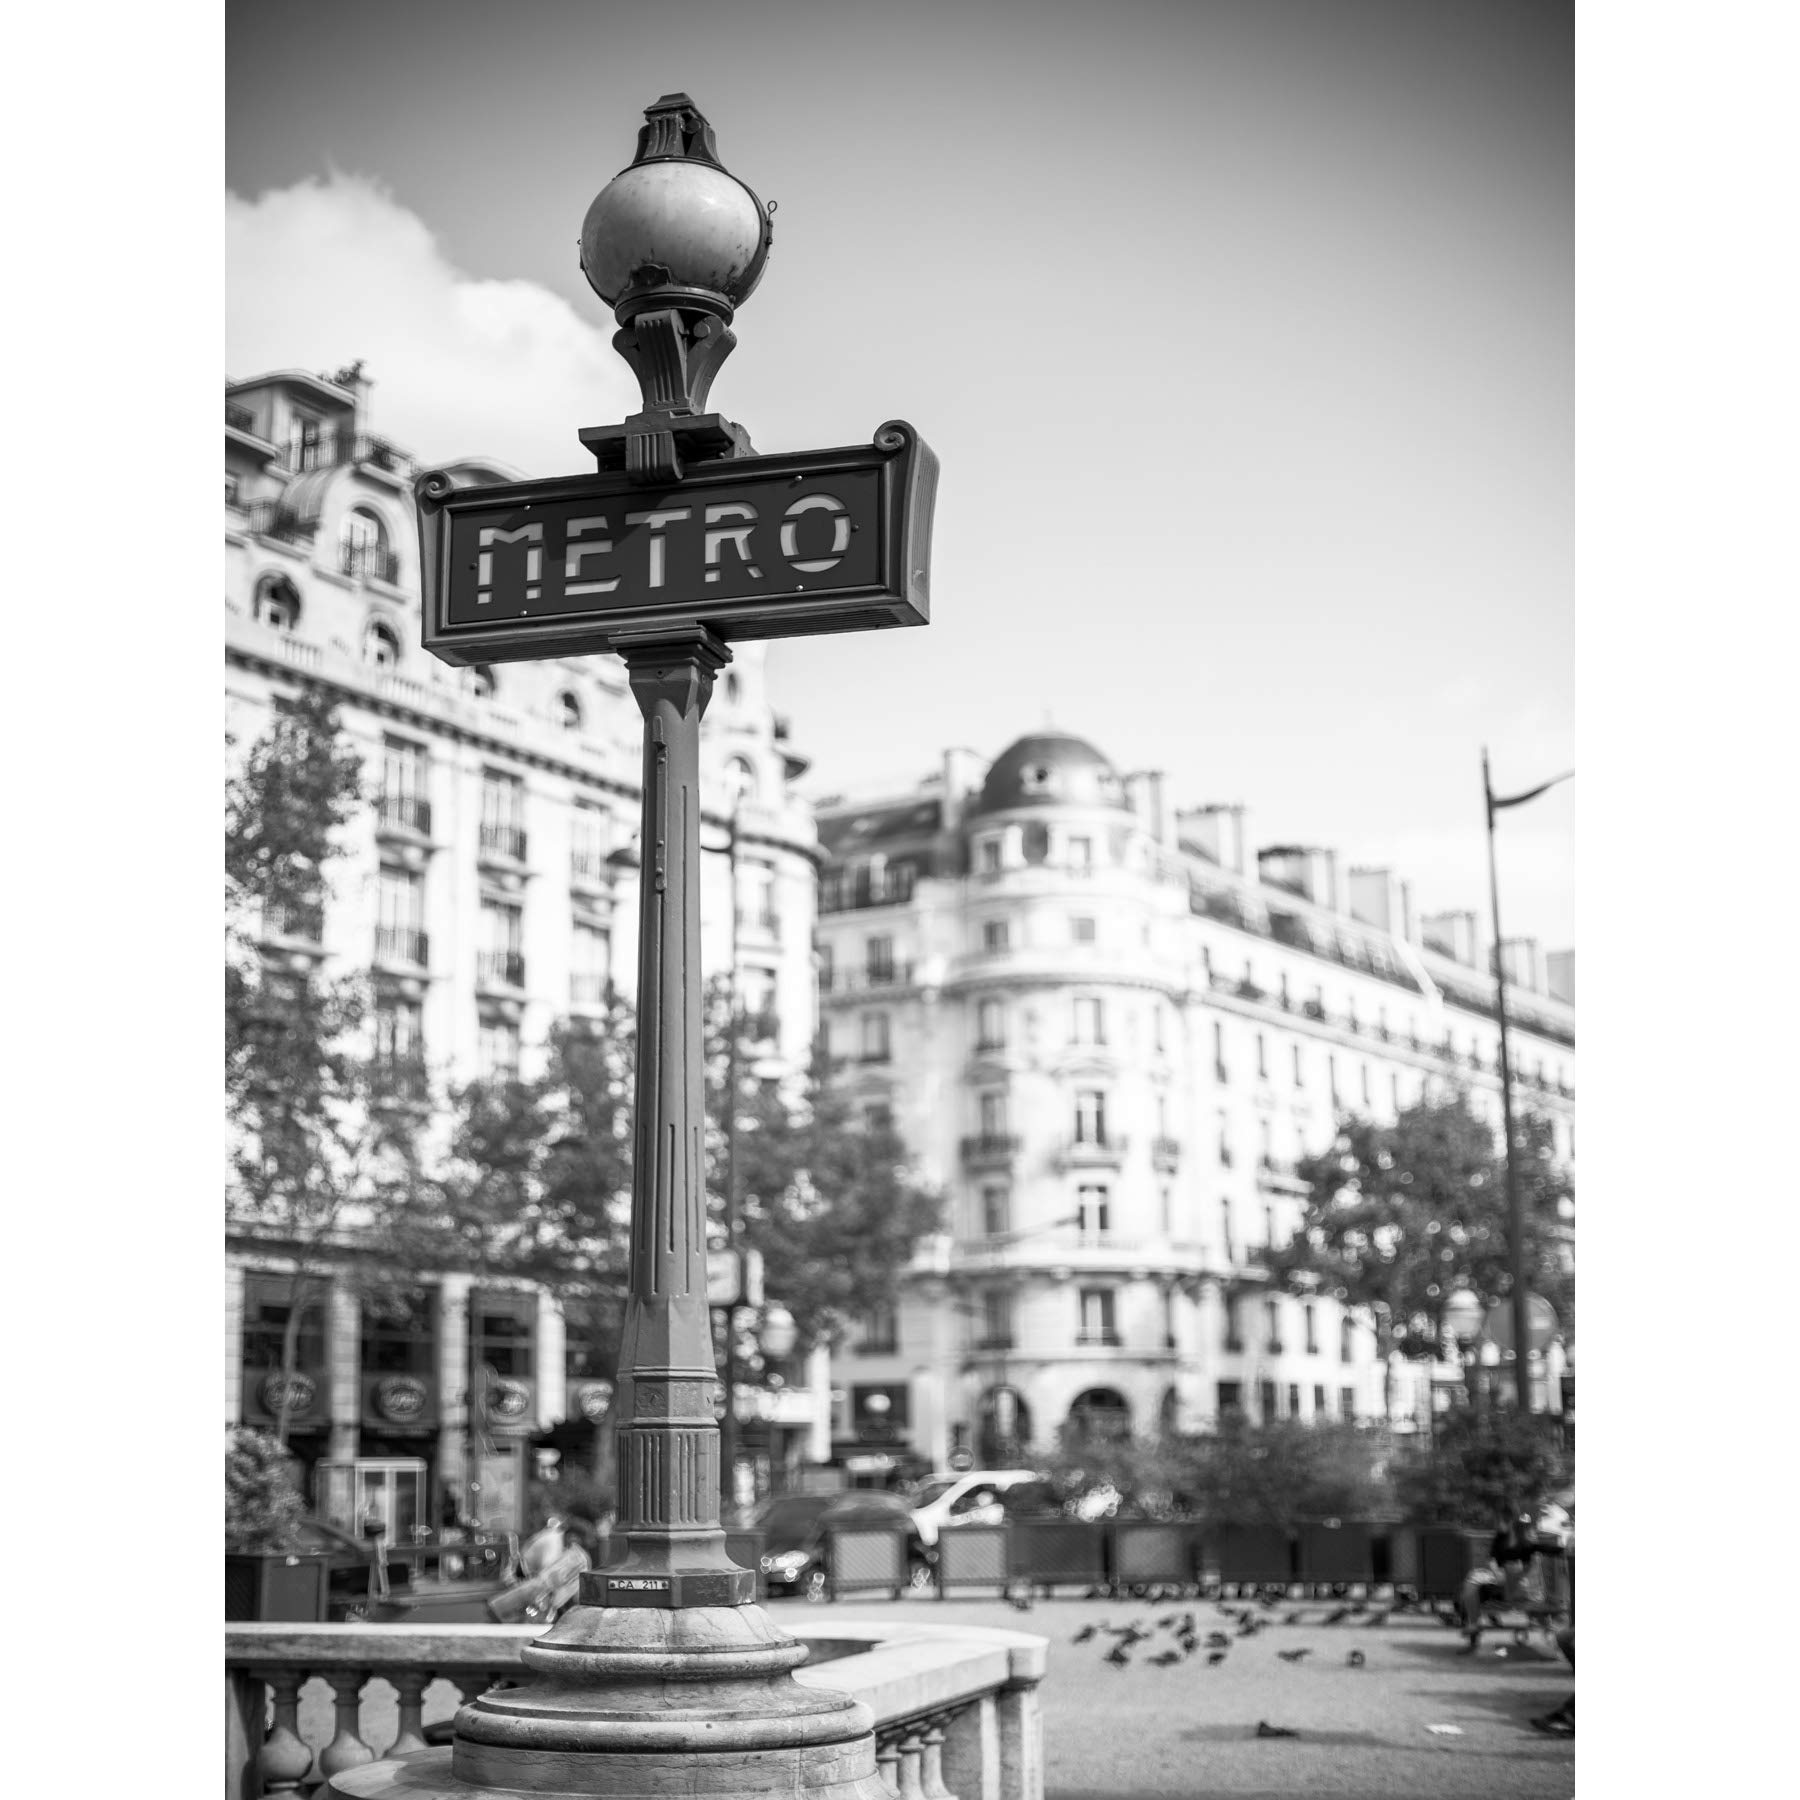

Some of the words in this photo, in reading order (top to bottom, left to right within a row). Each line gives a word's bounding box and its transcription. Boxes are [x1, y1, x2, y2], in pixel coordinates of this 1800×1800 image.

[476, 492, 852, 605] METRO
[618, 1580, 634, 1590] CA
[642, 1580, 658, 1590] 211
